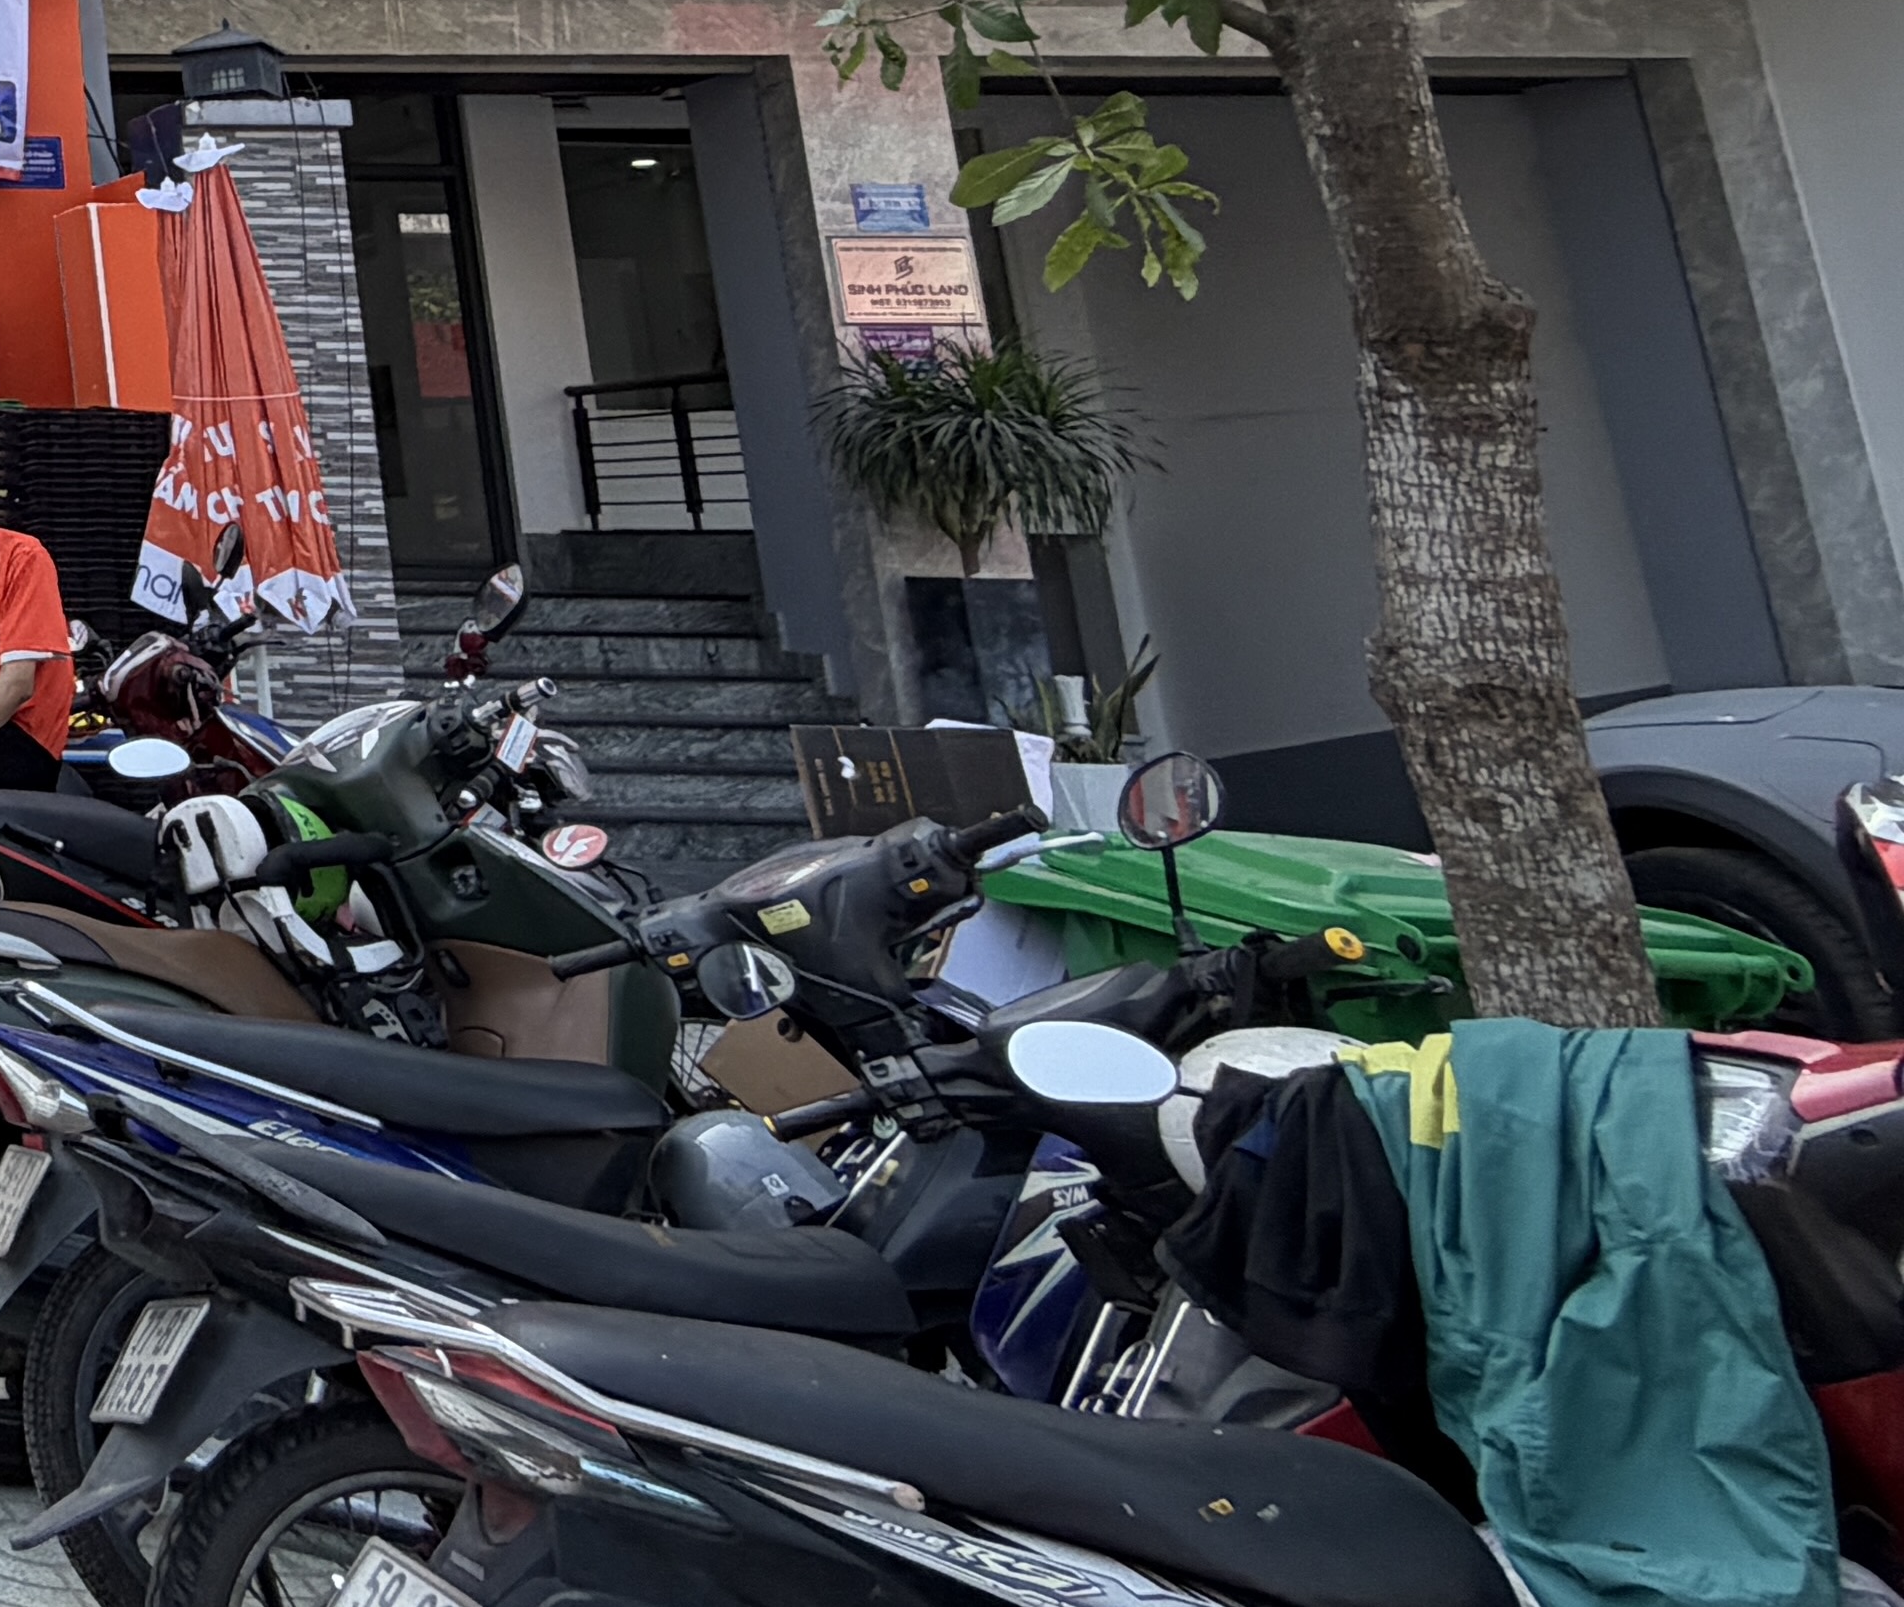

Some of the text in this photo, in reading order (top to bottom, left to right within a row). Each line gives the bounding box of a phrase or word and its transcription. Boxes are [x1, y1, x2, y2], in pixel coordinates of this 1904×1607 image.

[847, 280, 969, 296] SINH PHÚC LAND
[1052, 1184, 1089, 1208] SYM
